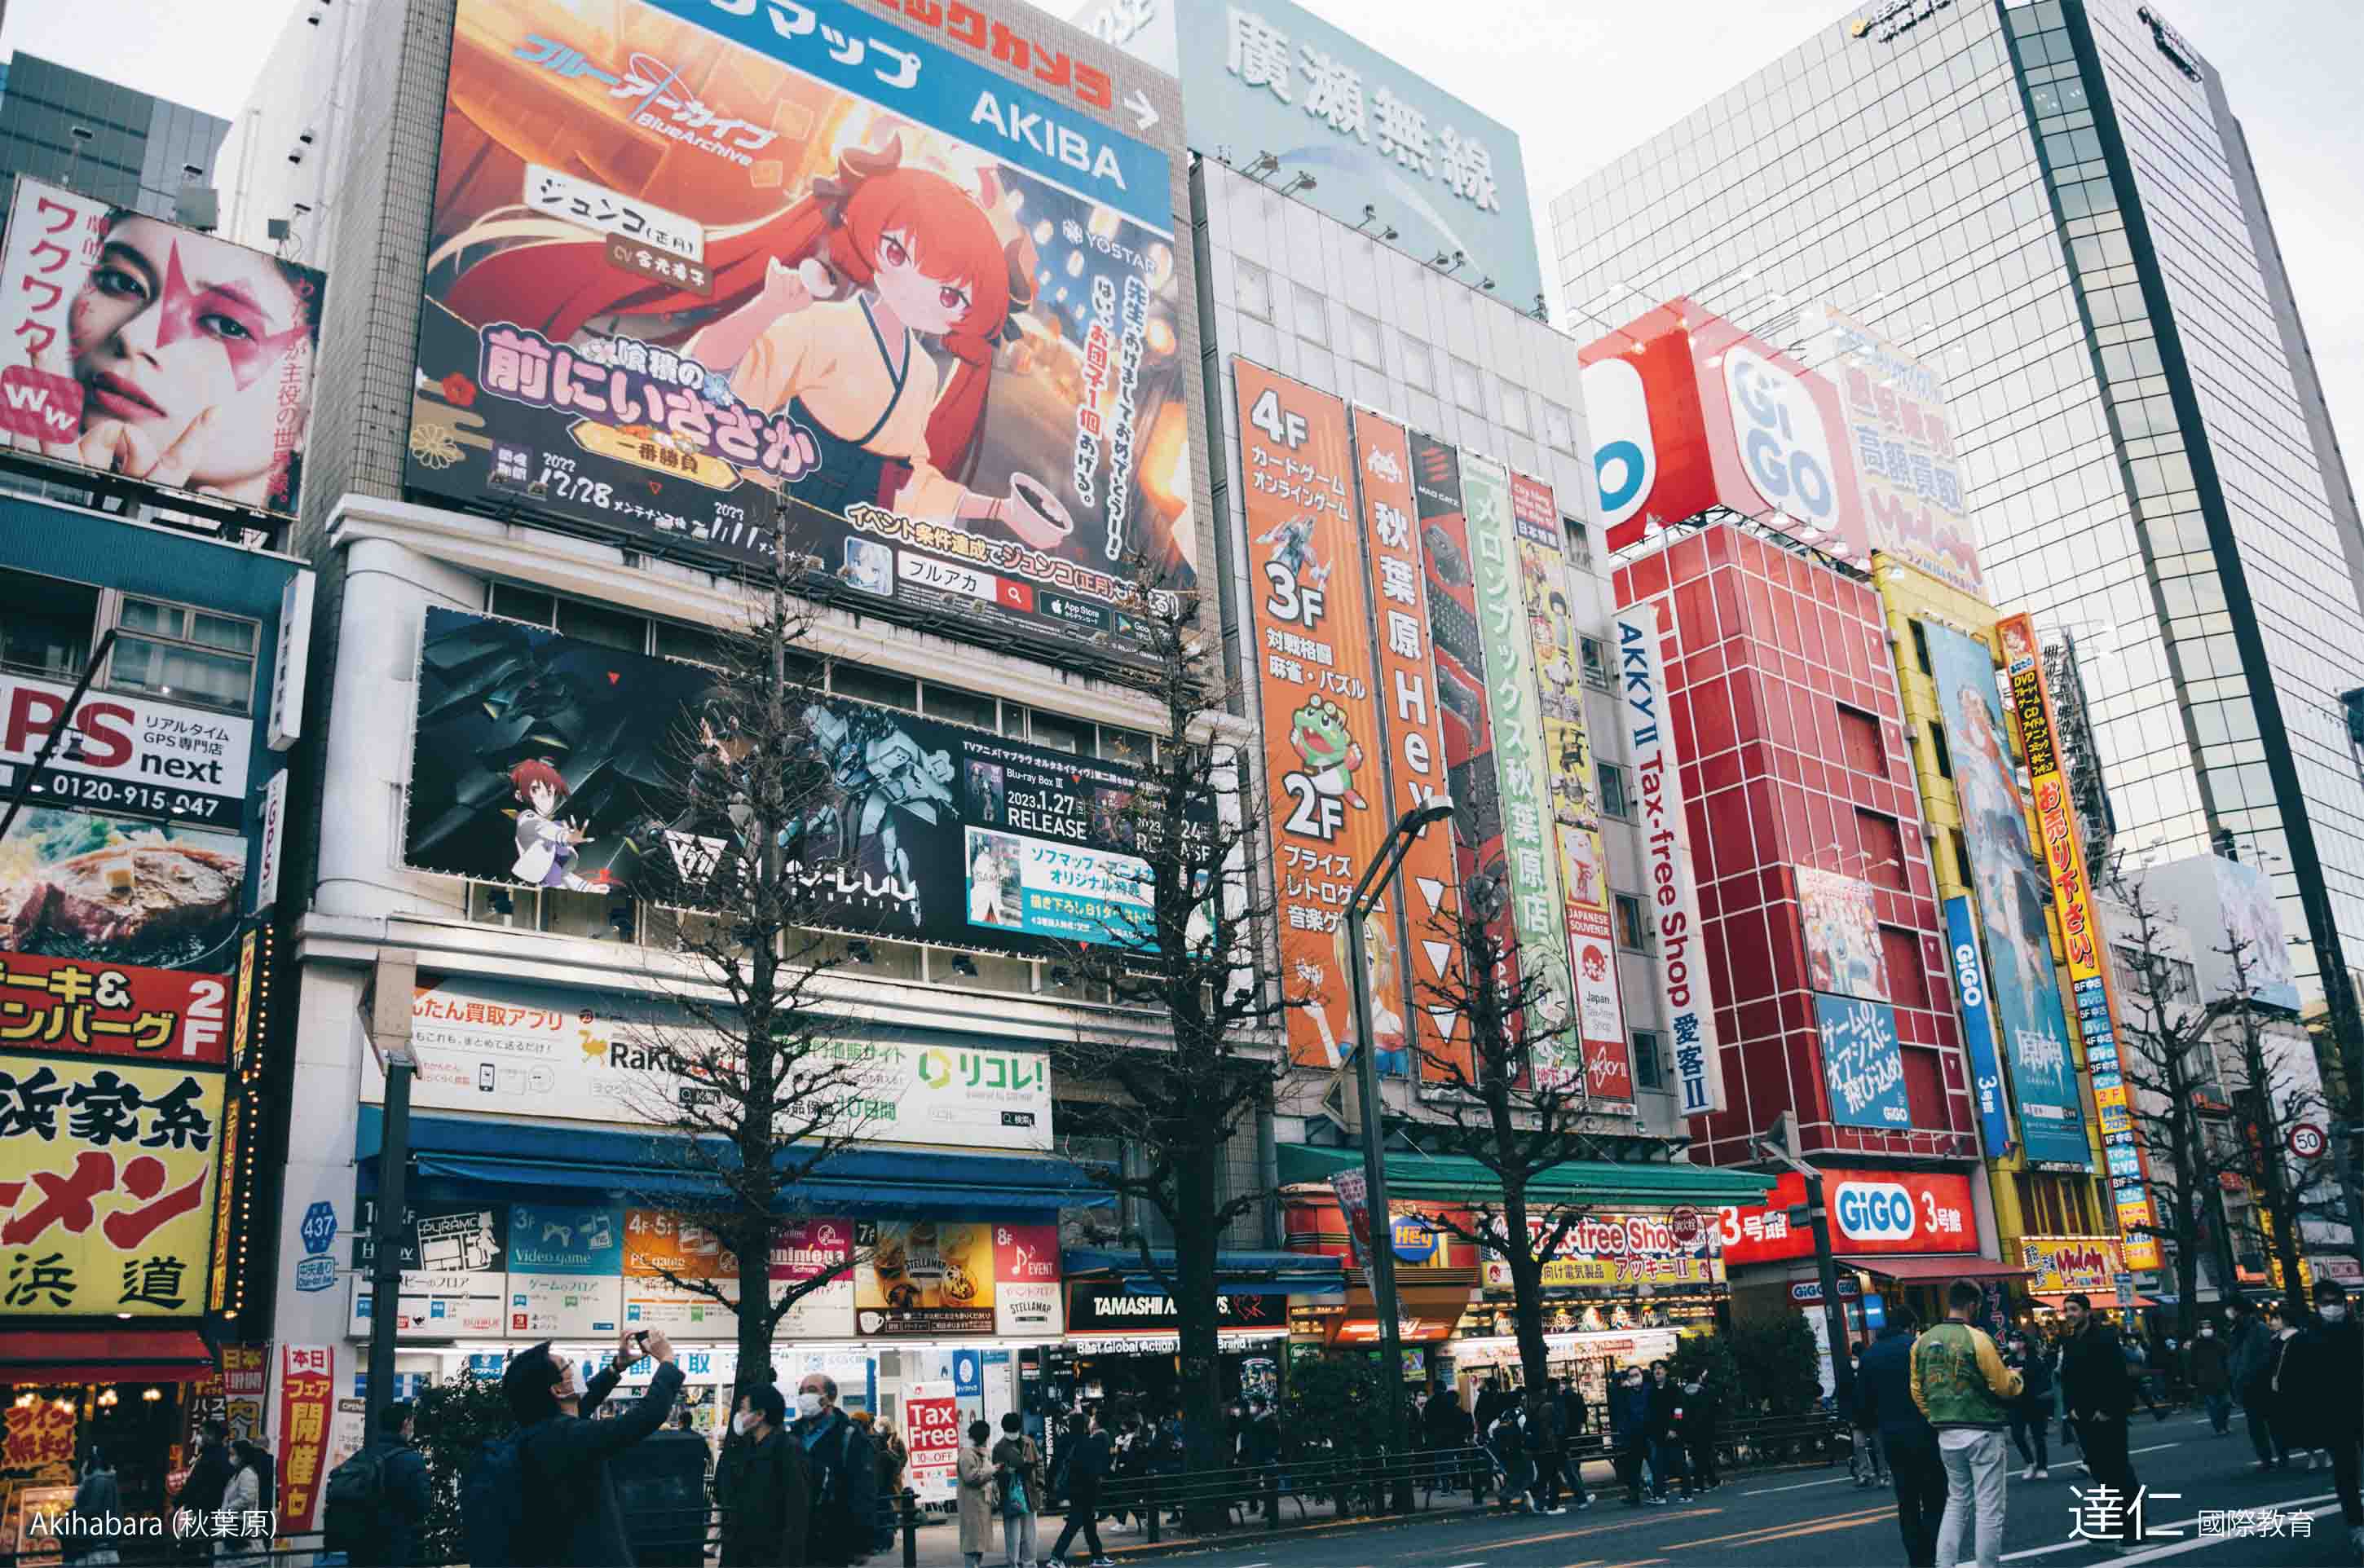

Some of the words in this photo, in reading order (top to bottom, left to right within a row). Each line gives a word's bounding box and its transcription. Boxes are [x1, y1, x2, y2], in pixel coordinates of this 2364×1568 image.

[880, 0, 1112, 110] ックカメラ
[971, 90, 1127, 190] AKIBA
[1087, 232, 1158, 275] YOSTAR
[1251, 388, 1309, 450] 4F
[616, 439, 699, 474] 一番勝負
[1252, 446, 1347, 499] カードゲーム
[1746, 427, 1833, 518] GO
[1253, 471, 1351, 522] オンラインゲーム
[908, 561, 978, 592] ブルアカ
[1264, 560, 1325, 628] 3F
[1065, 601, 1080, 615] App
[1081, 606, 1100, 618] Store
[2013, 672, 2035, 687] DVD
[2024, 707, 2040, 719] CD
[144, 715, 230, 742] リアルタイム
[2025, 727, 2049, 742] アニメ
[143, 731, 176, 749] GPS
[179, 736, 223, 756] 専門店
[140, 752, 223, 786] next
[1007, 768, 1036, 784] Blu-ray
[1039, 774, 1054, 786] Box
[1008, 789, 1074, 816] 2023.1.27
[1282, 771, 1345, 840] 2F
[1617, 619, 1655, 719] AKKY
[1639, 750, 1677, 908] Tax-free
[1661, 912, 1691, 1008] Shop
[1008, 807, 1088, 841] RELEASE
[1284, 845, 1352, 879] プライズ
[1568, 911, 1609, 927] JAPANESE
[1569, 920, 1611, 937] SOUVENIR
[0, 965, 132, 1011] ーキ&
[183, 979, 226, 1056] 2F
[2295, 1133, 2319, 1149] 50
[514, 1210, 536, 1228] 3F
[1839, 1190, 1912, 1231] GiGO
[304, 1216, 333, 1238] 437
[996, 1227, 1013, 1246] 8F
[1629, 1217, 1670, 1253] Sho
[515, 1248, 550, 1262] Video
[551, 1252, 592, 1265] game
[1028, 1262, 1053, 1276] EVENT
[1094, 1297, 1163, 1316] TAMASHII
[292, 1350, 324, 1368] 本日
[1076, 1340, 1102, 1354] Best
[1105, 1339, 1140, 1354] Global
[1141, 1338, 1175, 1351] Action
[286, 1379, 331, 1398] フェア
[910, 1403, 953, 1426] Tax
[909, 1425, 958, 1448] Free
[287, 1402, 324, 1517] 開催中
